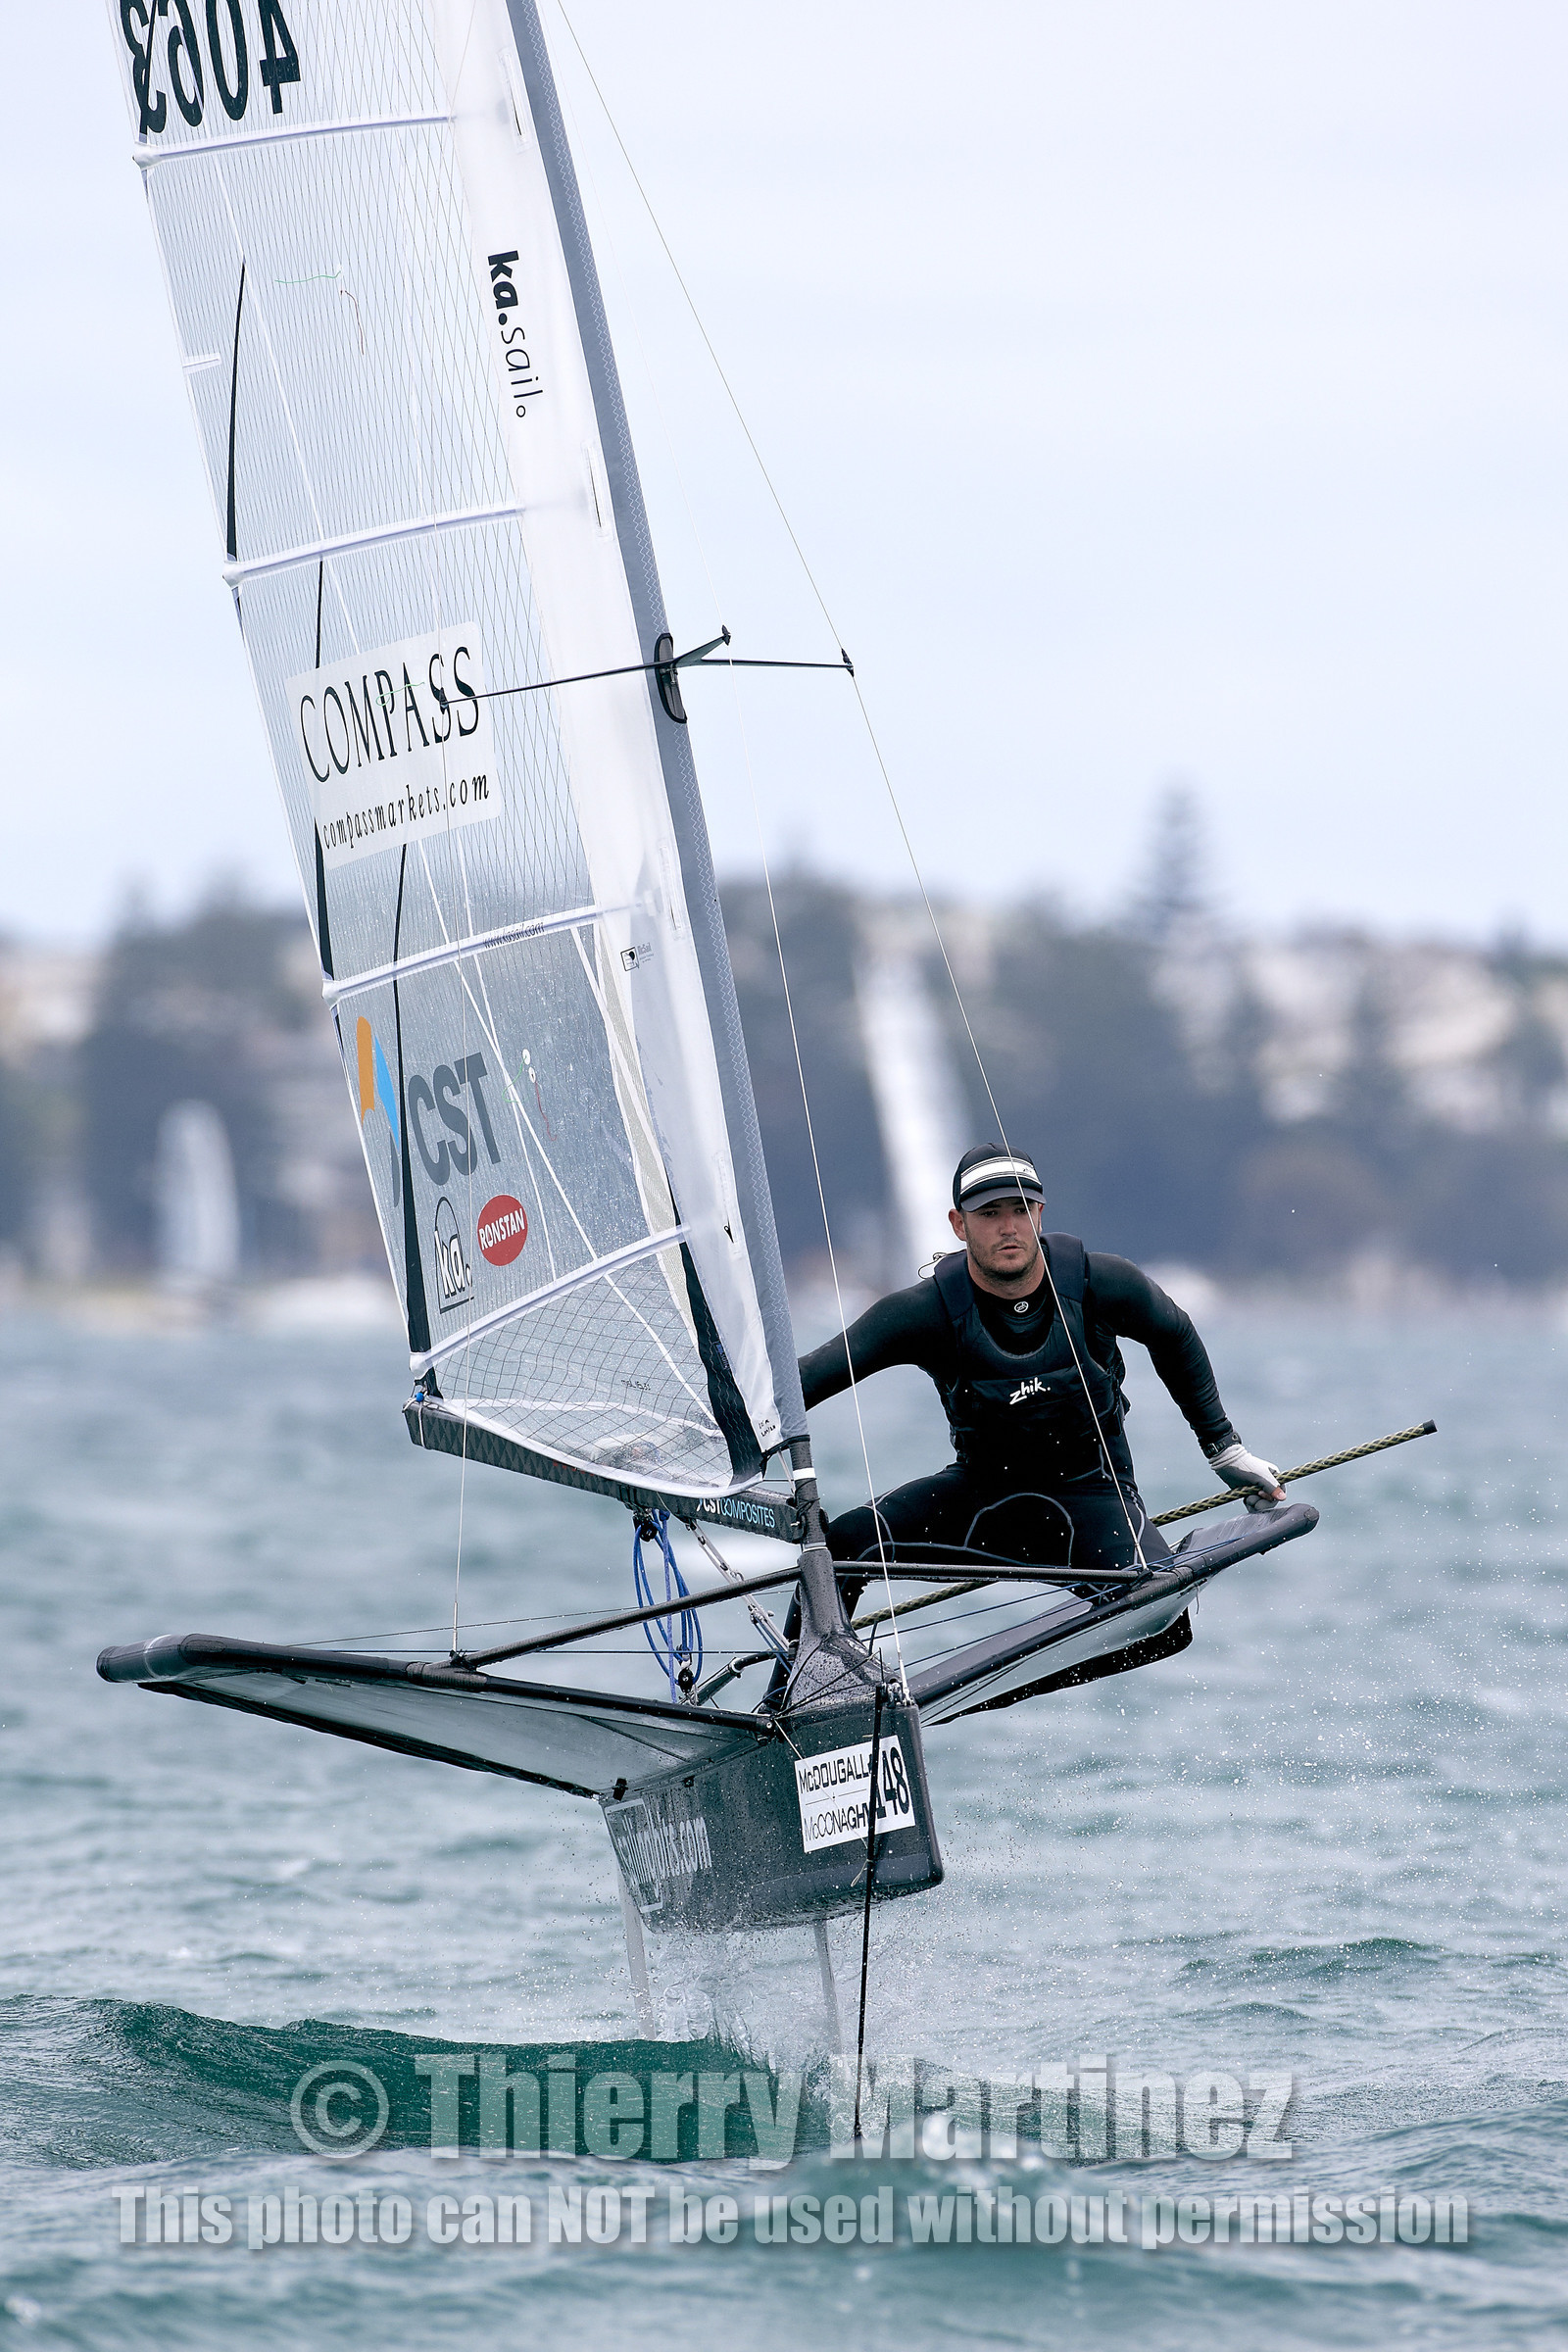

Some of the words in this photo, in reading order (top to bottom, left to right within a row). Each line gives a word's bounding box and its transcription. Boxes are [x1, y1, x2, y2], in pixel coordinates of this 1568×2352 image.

[299, 646, 480, 783] COMPASS
[321, 772, 490, 851] compassmarkets.com
[407, 1052, 502, 1187] CST
[478, 1207, 525, 1250] RONSTAN
